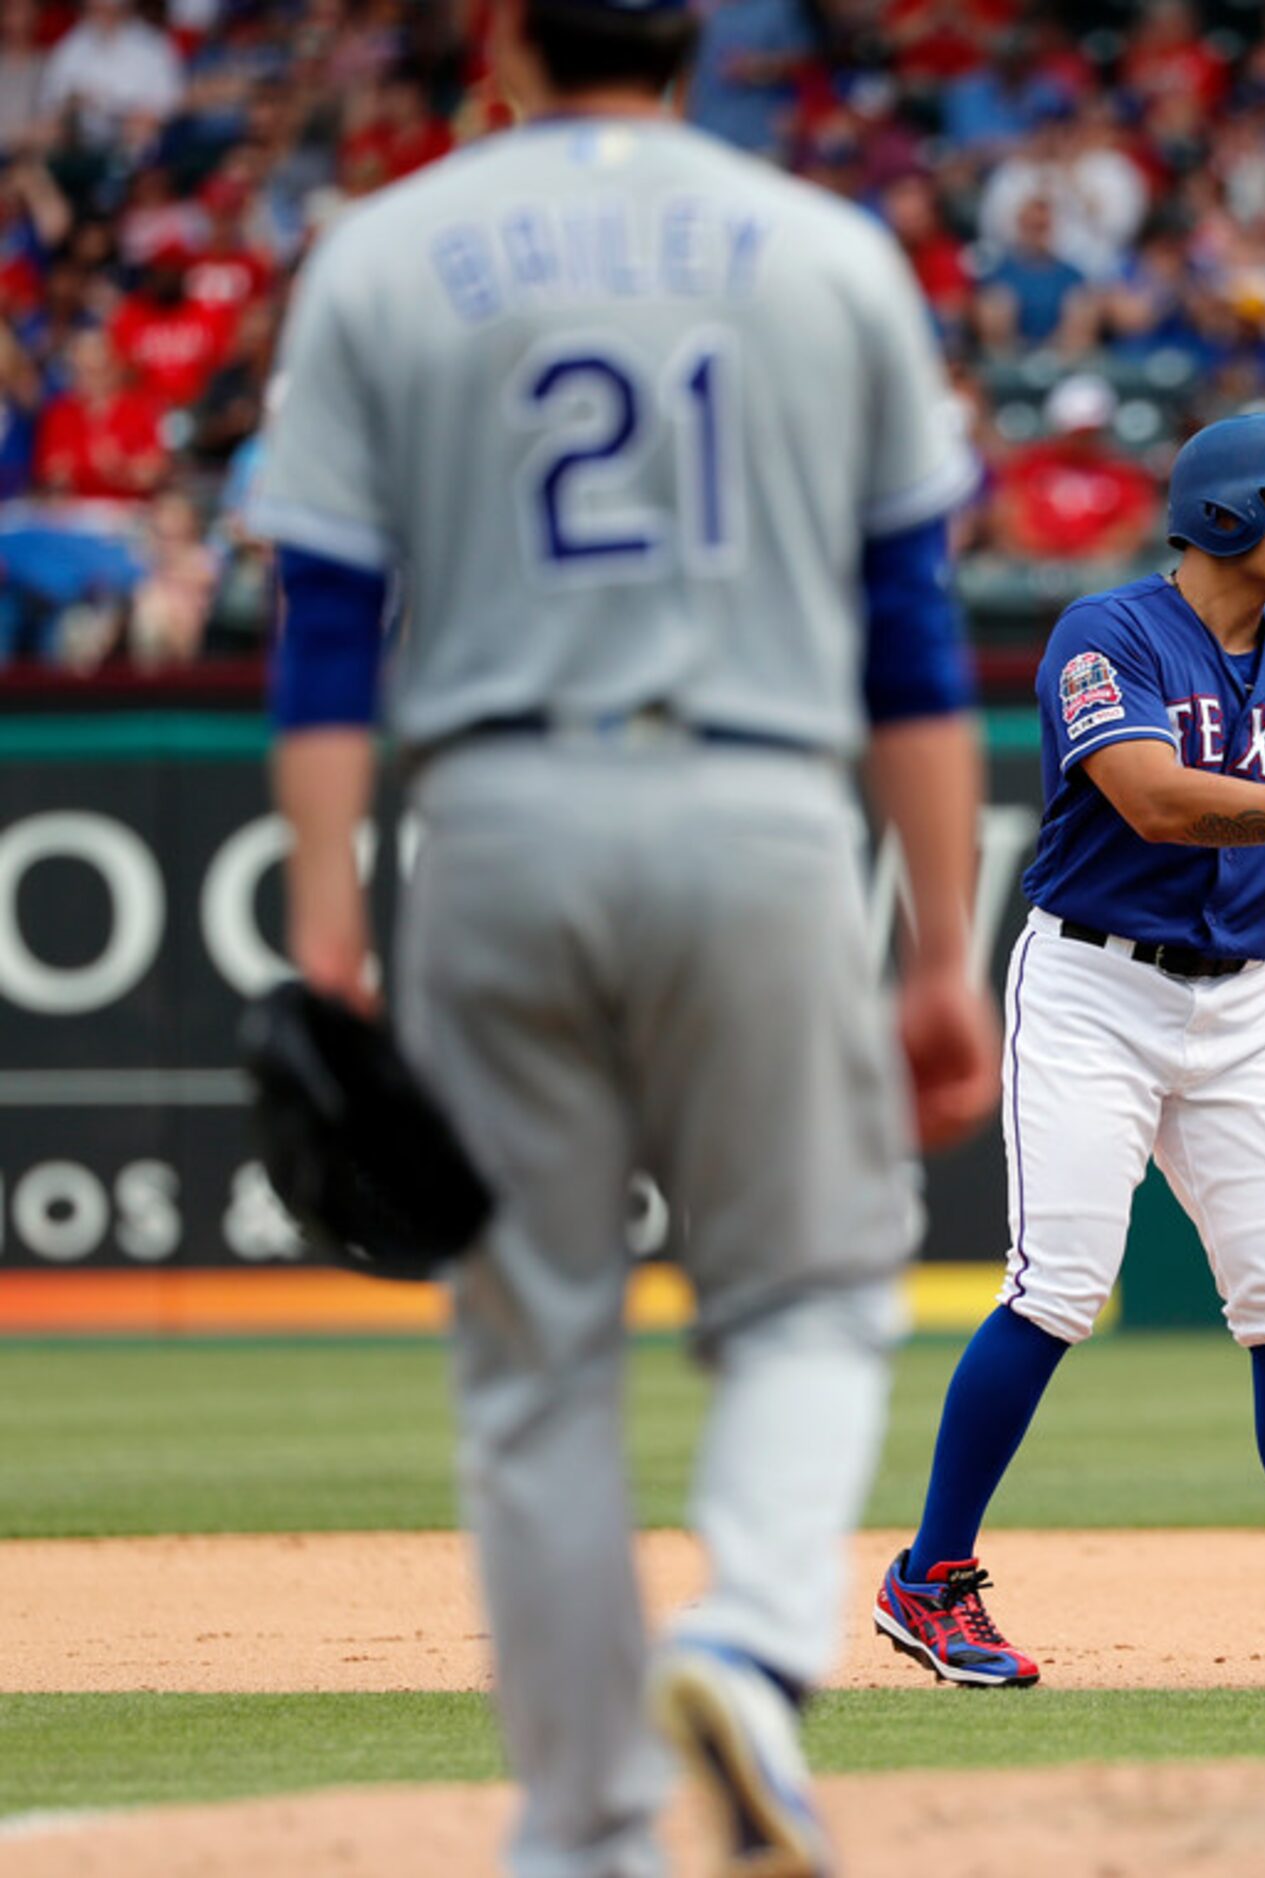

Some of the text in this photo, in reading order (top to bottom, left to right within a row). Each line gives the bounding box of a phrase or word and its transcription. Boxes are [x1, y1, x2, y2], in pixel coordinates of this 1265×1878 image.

[429, 193, 768, 326] BAILEY
[516, 338, 738, 582] 21
[0, 1157, 183, 1263] OS
